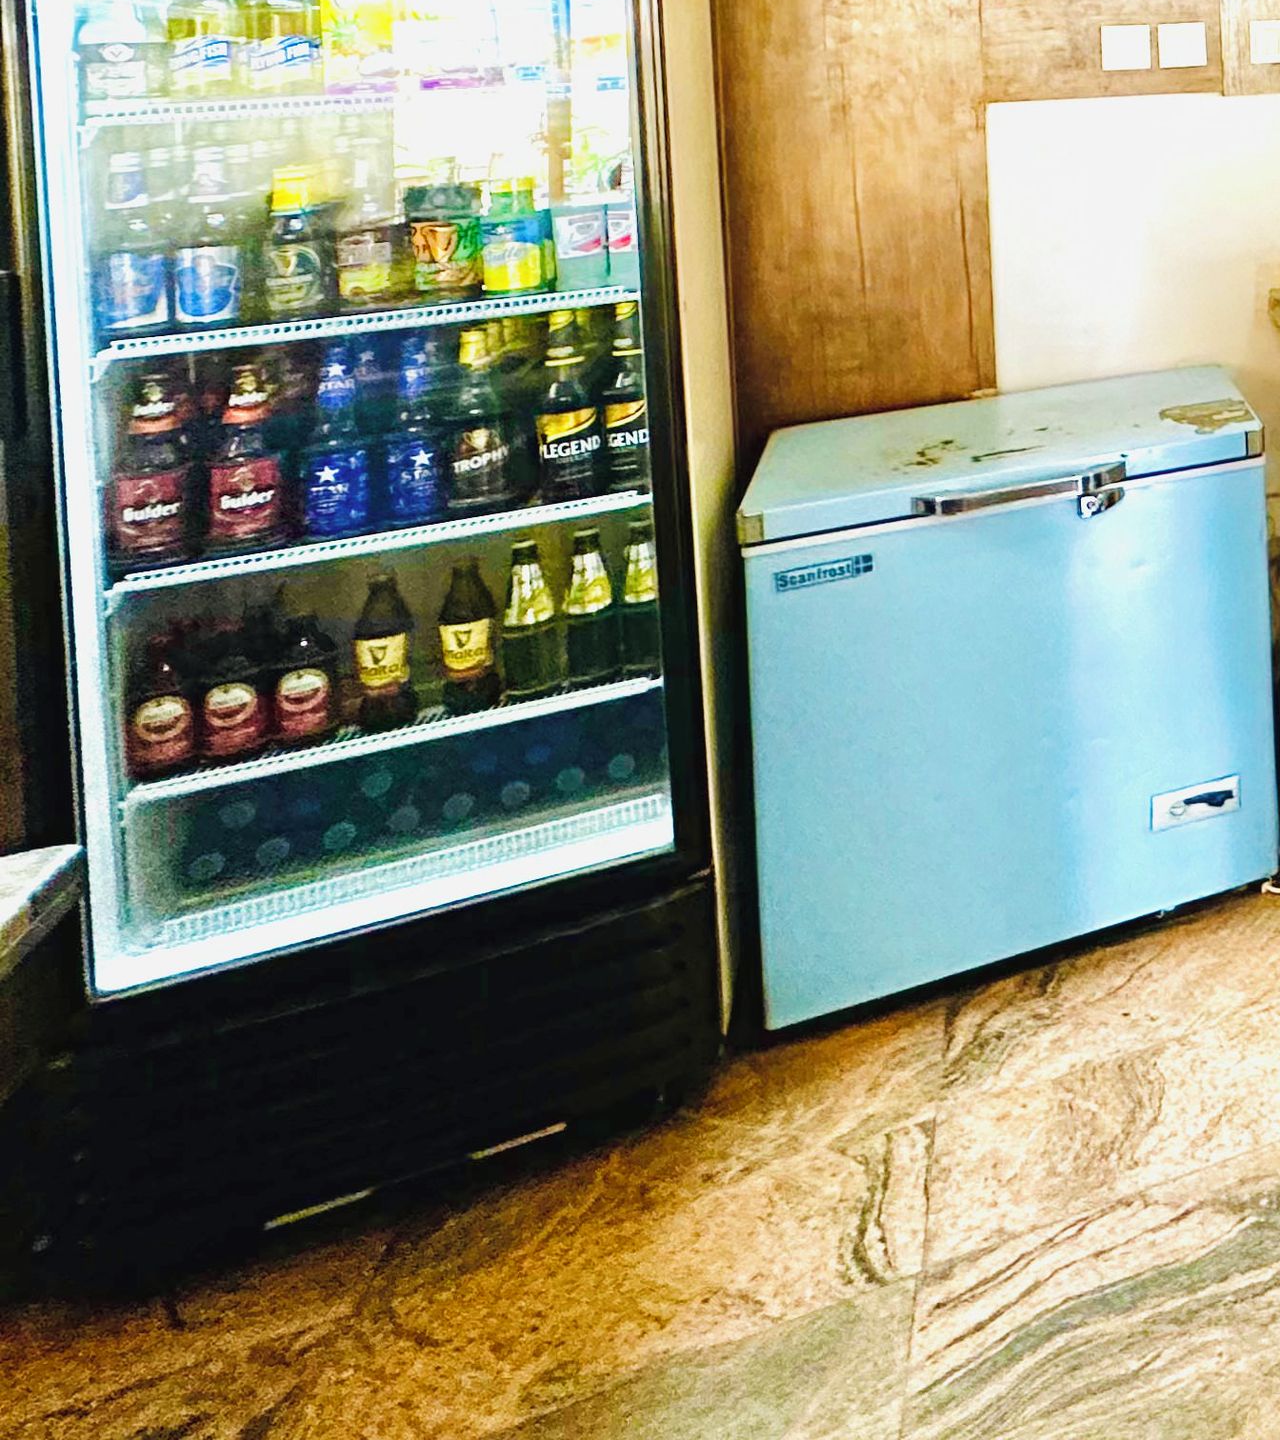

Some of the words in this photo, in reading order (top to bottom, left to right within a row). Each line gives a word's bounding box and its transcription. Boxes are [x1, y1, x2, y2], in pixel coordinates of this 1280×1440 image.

[451, 444, 510, 474] TROPHY
[543, 435, 602, 459] LEGEND
[779, 559, 852, 588] Scanfrost
